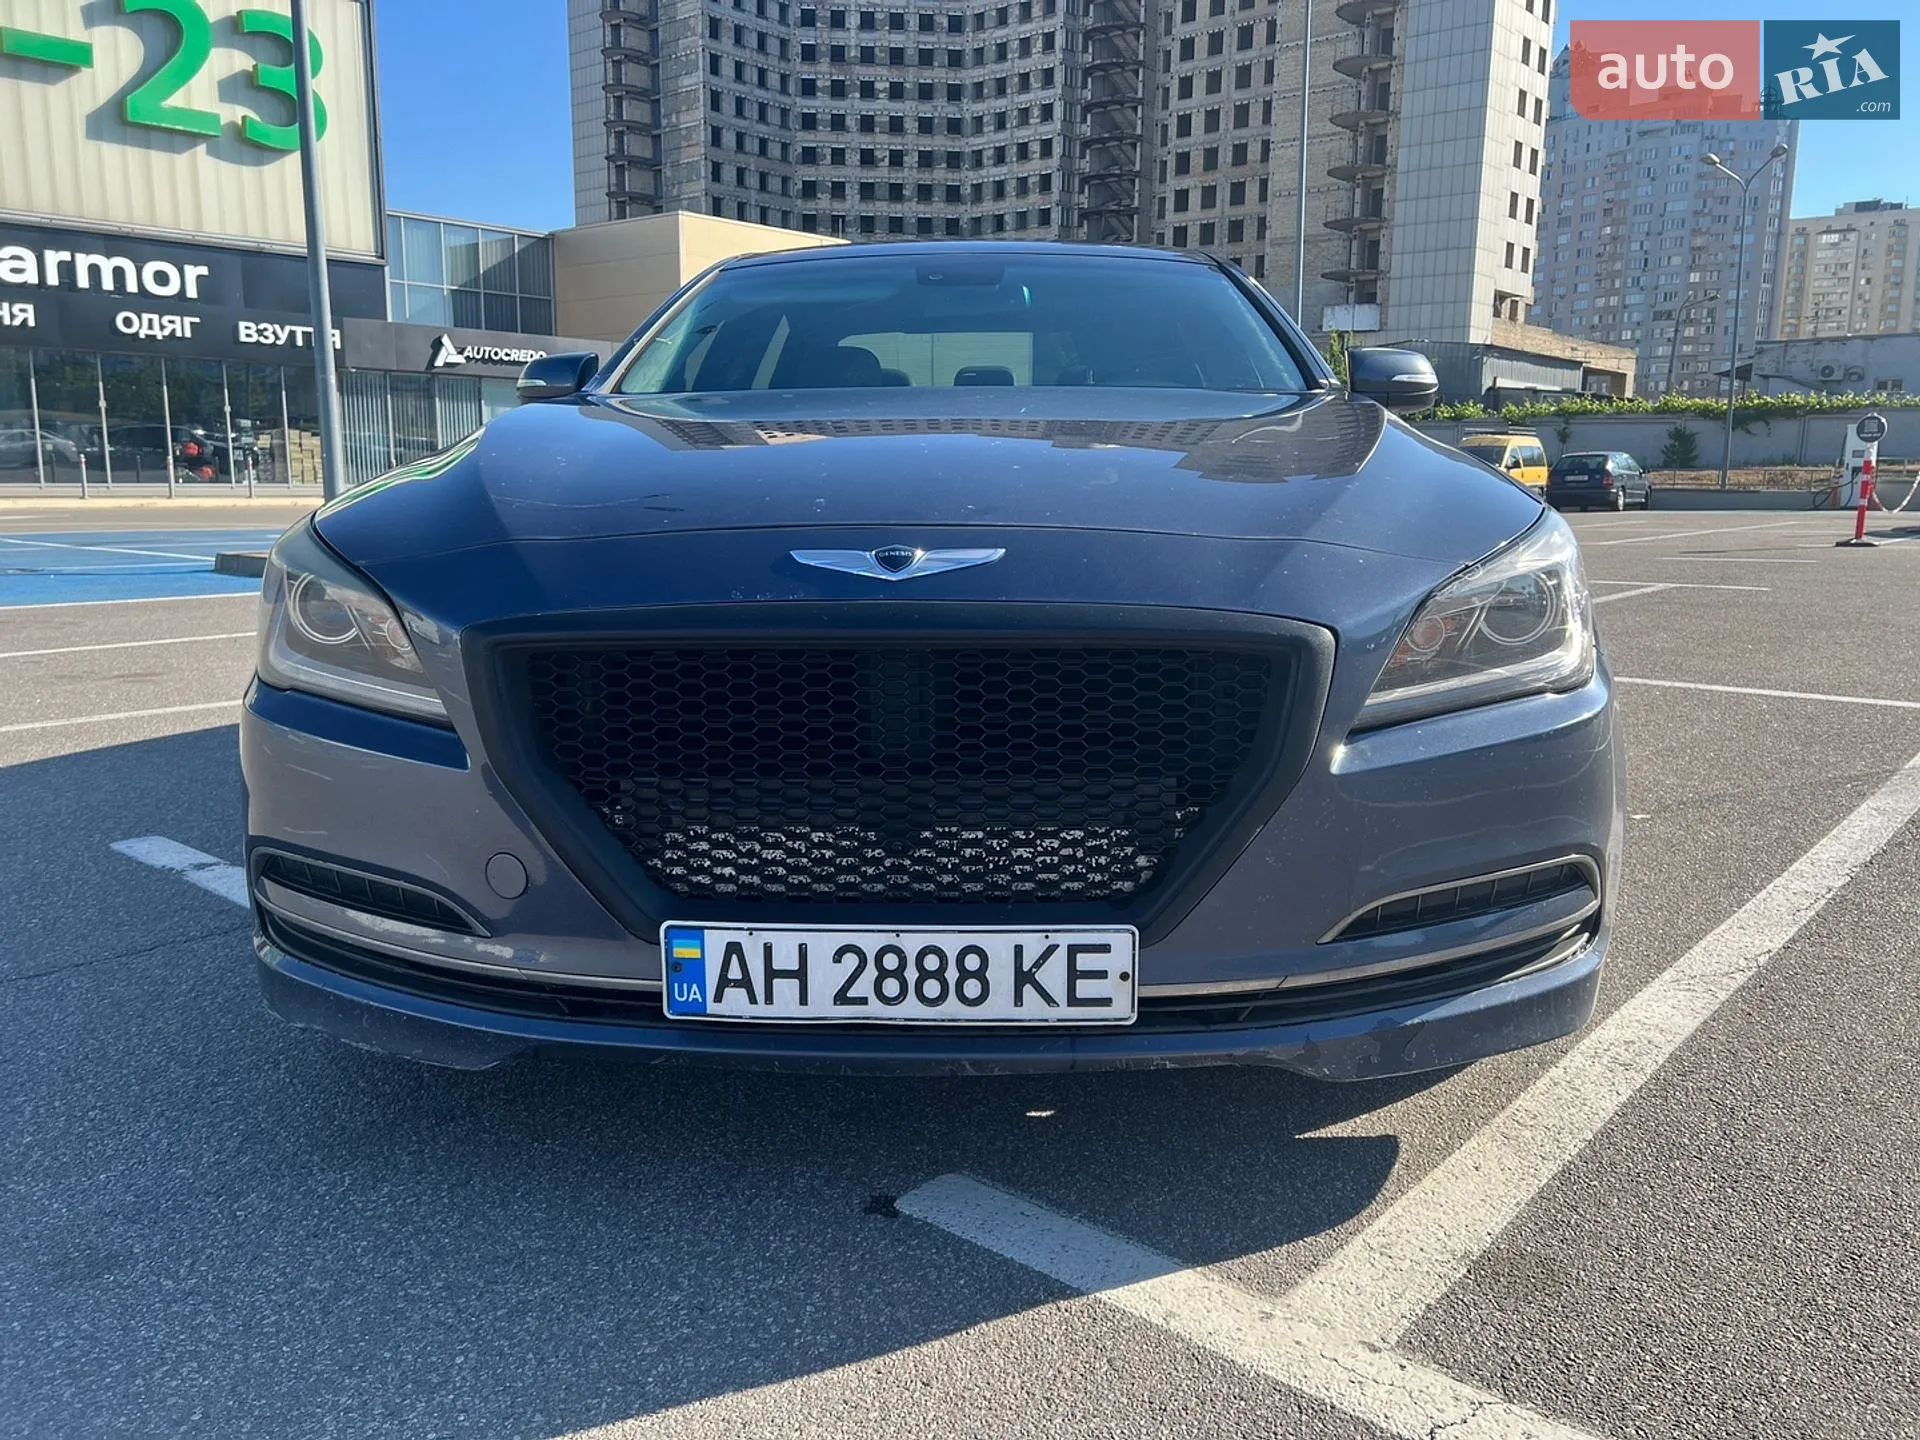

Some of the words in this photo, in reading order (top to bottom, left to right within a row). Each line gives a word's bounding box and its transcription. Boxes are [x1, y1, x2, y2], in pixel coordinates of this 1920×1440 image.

[0, 245, 209, 299] armor
[115, 311, 200, 339] ОДЯГ
[674, 982, 702, 1003] UA
[712, 942, 808, 1006] AH
[832, 944, 990, 1007] 2888
[1013, 944, 1113, 1008] KE
